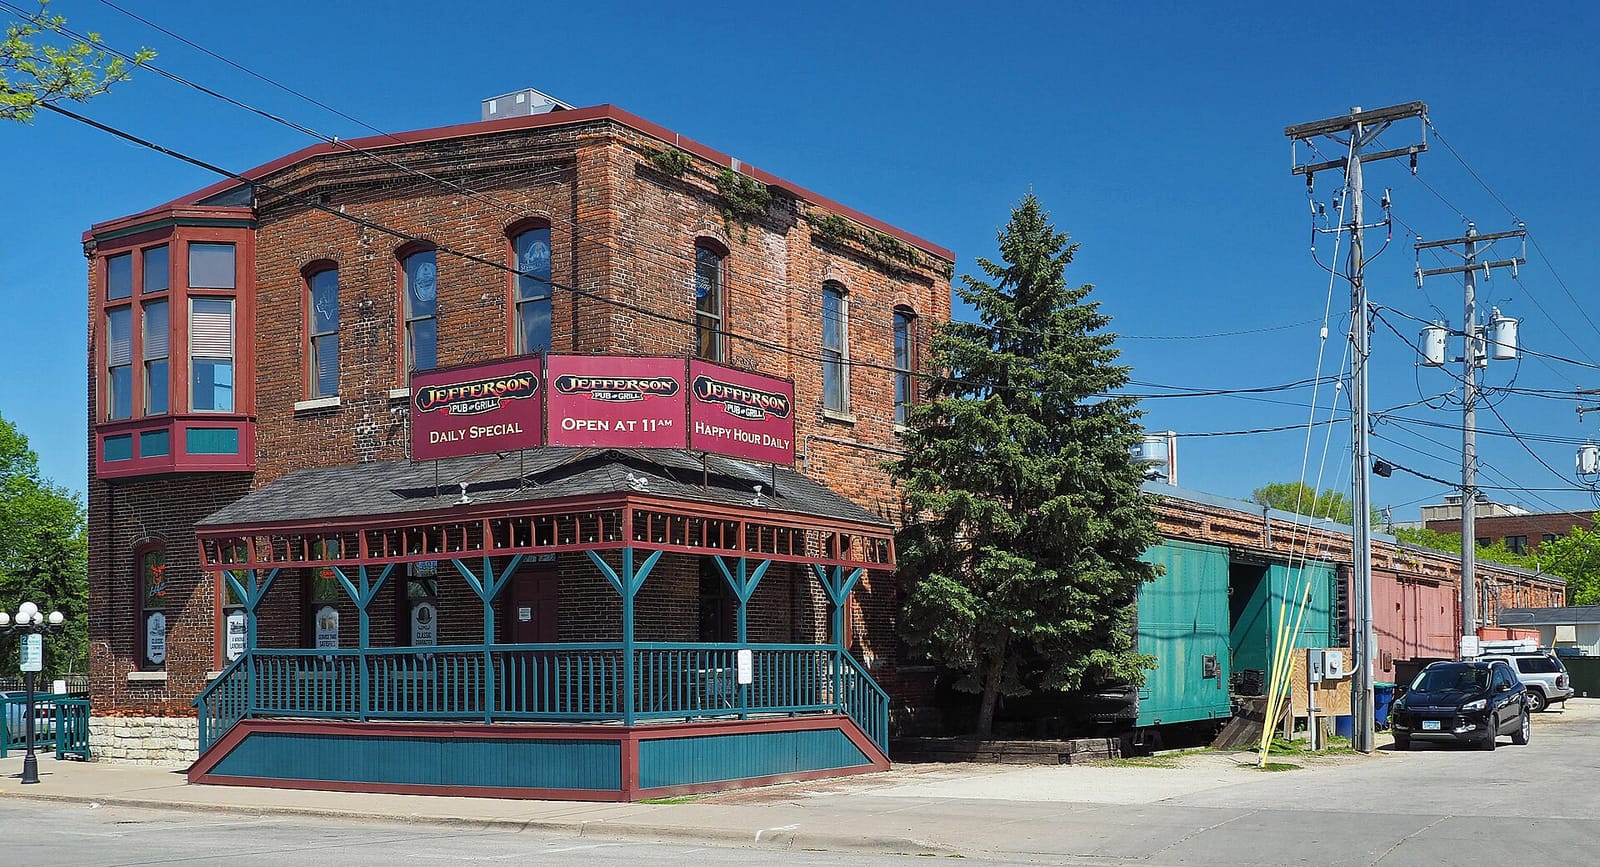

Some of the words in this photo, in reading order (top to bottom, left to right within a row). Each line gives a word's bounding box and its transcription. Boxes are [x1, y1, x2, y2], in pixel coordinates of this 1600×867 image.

[560, 377, 674, 391] JEFFERSON
[420, 377, 532, 408] JEFFERSON
[594, 392, 612, 400] PUB
[618, 392, 641, 400] GRILL
[698, 380, 787, 411] JEFFERSON
[452, 404, 468, 413] PUB
[474, 399, 497, 411] GRILL
[727, 403, 741, 415] PUB
[745, 407, 763, 418] GRILL
[561, 417, 609, 431] OPEN
[614, 420, 637, 432] AT
[429, 429, 467, 444] DAILY
[469, 422, 523, 439] SPECIAL
[695, 421, 732, 440] HAPPY
[733, 428, 761, 445] HOUR
[763, 434, 790, 450] DAILY
